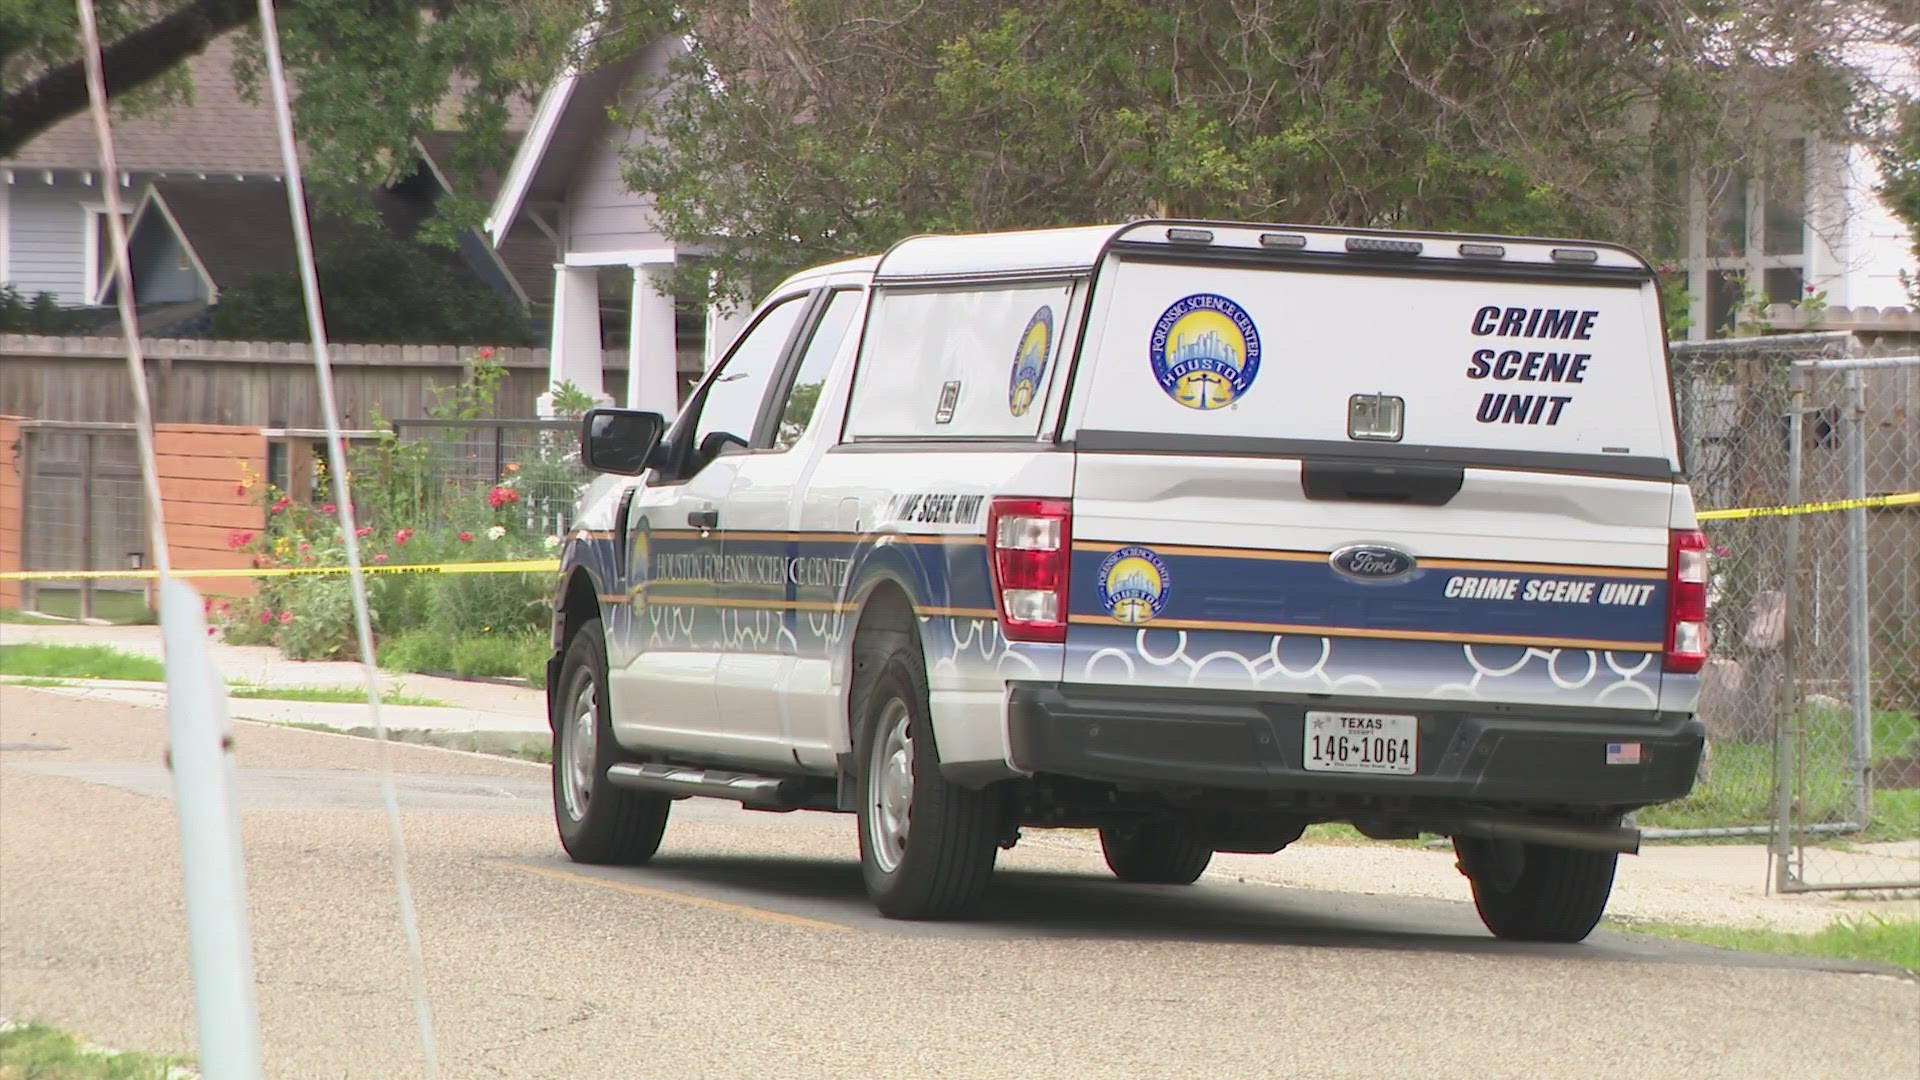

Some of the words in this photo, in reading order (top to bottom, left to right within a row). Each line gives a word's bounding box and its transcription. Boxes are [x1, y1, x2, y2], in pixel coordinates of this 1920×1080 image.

[1152, 302, 1188, 352] FORENSIC
[1187, 296, 1237, 316] SCIENCE
[1233, 311, 1260, 358] CENTER
[1471, 305, 1599, 341] CRIME
[1161, 358, 1247, 391] HOUSTON
[1466, 349, 1592, 383] SCENE
[1475, 393, 1572, 426] UNIT
[917, 493, 957, 523] SCENE
[954, 494, 984, 524] UNIT
[656, 553, 703, 581] HOUSTON
[704, 553, 756, 584] FORENSIC
[756, 556, 806, 585] SCIENCE
[807, 556, 853, 587] CENTE
[1349, 551, 1397, 574] Ford
[1104, 589, 1161, 612] HOUSTON
[1444, 576, 1520, 600] CRIME
[1522, 579, 1596, 604] SCENE
[1599, 583, 1655, 607] UNIT
[1341, 717, 1383, 730] TEXAS
[1312, 735, 1349, 761] 146
[1361, 737, 1409, 765] 1064
